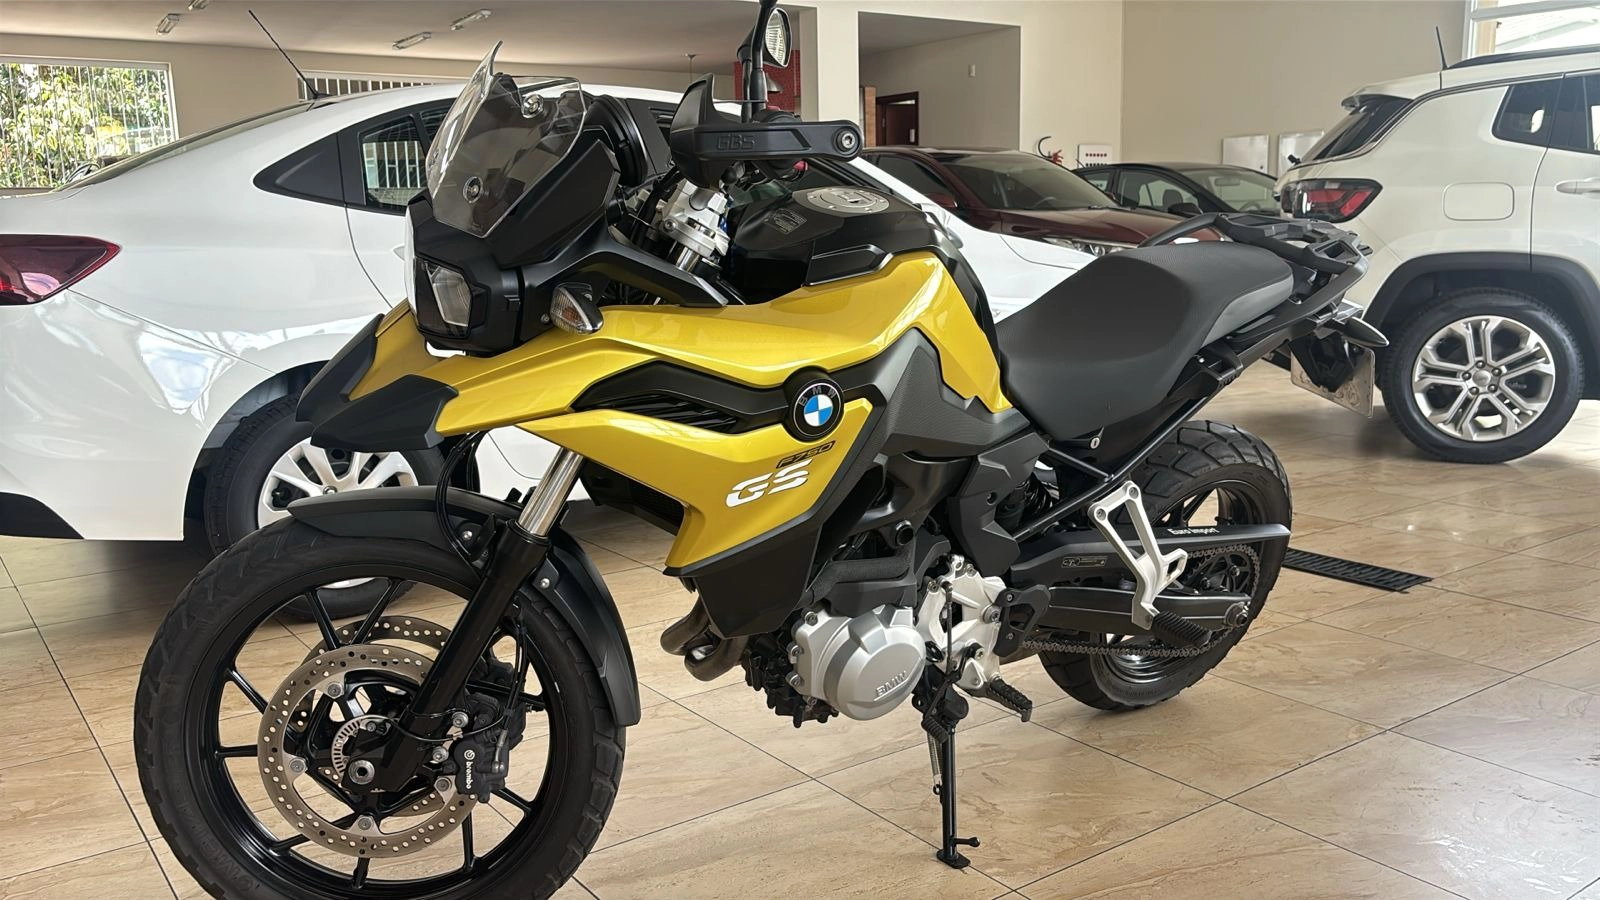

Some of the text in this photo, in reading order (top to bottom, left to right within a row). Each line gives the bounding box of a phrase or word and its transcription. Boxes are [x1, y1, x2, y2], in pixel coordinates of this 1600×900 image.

[798, 385, 837, 406] BMW
[775, 440, 836, 469] F750
[725, 458, 813, 508] GS
[875, 670, 906, 697] BMW
[465, 761, 474, 790] brembo
